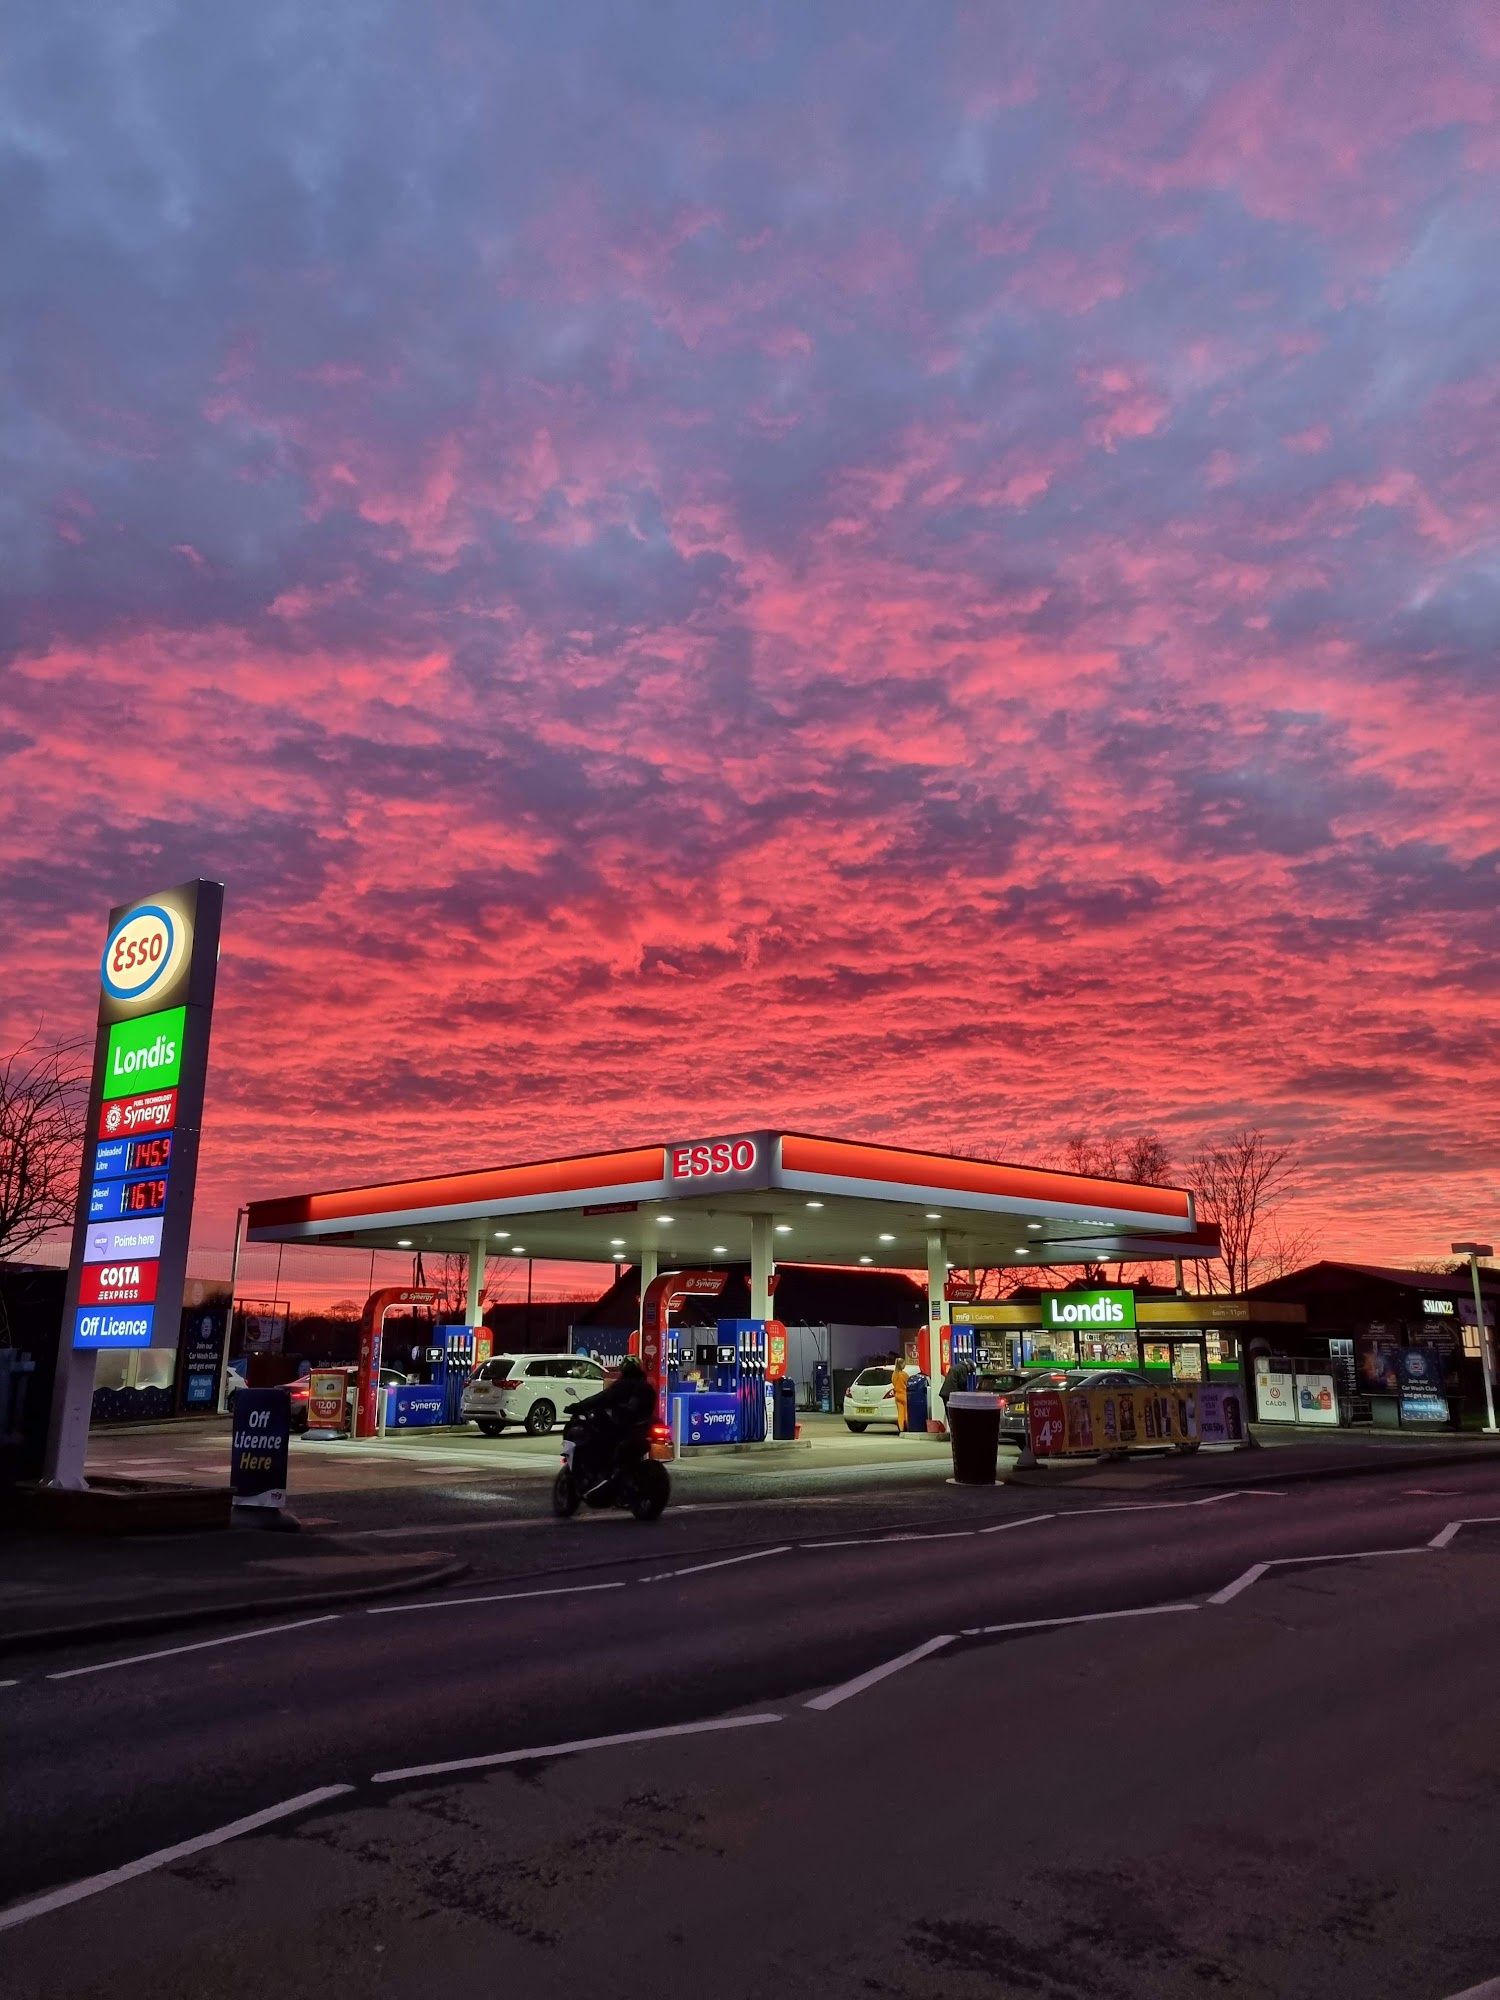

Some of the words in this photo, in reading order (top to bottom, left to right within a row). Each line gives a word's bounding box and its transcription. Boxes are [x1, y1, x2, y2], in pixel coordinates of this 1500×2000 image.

[113, 1034, 176, 1076] Londis
[144, 1093, 173, 1105] TECHNOLOGY
[123, 1103, 172, 1129] Synergy
[97, 1145, 123, 1158] Unleaded
[135, 1138, 171, 1167] 145.9
[96, 1161, 109, 1171] Litre
[92, 1187, 110, 1198] Diesel
[131, 1180, 166, 1210] 167.9
[91, 1202, 104, 1212] Litre
[114, 1234, 137, 1248] Points
[138, 1233, 155, 1246] here
[100, 1266, 140, 1287] COSTA
[695, 1279, 721, 1289] Synergy
[98, 1289, 139, 1300] EXPRESS
[409, 1293, 434, 1302] Synergy
[1051, 1296, 1124, 1322] Londis
[1230, 1308, 1247, 1317] 11pm
[80, 1316, 101, 1337] Off
[100, 1316, 148, 1336] Licence
[410, 1400, 442, 1412] Synergy
[1033, 1407, 1051, 1418] ONLY
[248, 1410, 271, 1428] Off
[703, 1412, 736, 1426] Synergy
[234, 1430, 282, 1450] Licence
[239, 1451, 273, 1471] Here
